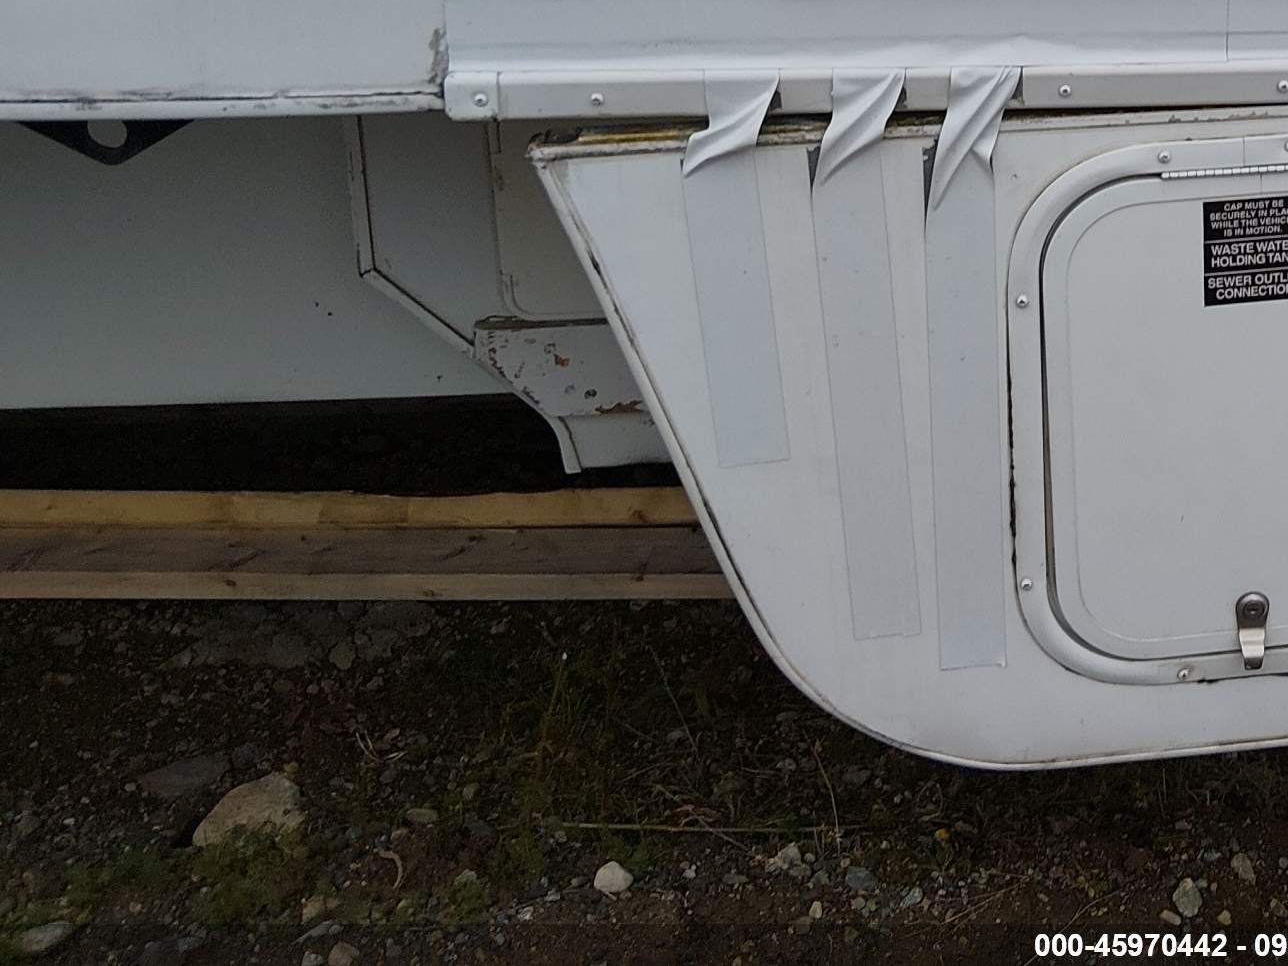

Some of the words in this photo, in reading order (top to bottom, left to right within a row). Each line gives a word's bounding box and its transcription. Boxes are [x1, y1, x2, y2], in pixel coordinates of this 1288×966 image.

[1224, 202, 1243, 212] CAP
[1245, 200, 1270, 210] MUST
[1272, 199, 1284, 208] BE
[1209, 209, 1256, 221] SECURELY
[1258, 208, 1268, 217] IN
[1211, 220, 1240, 229] WHILE
[1241, 218, 1259, 227] THE
[1224, 229, 1233, 237] IS
[1234, 228, 1244, 236] IN
[1211, 242, 1255, 256] WASTE
[1211, 253, 1266, 268] HOLDING
[1208, 275, 1252, 289] SEWER
